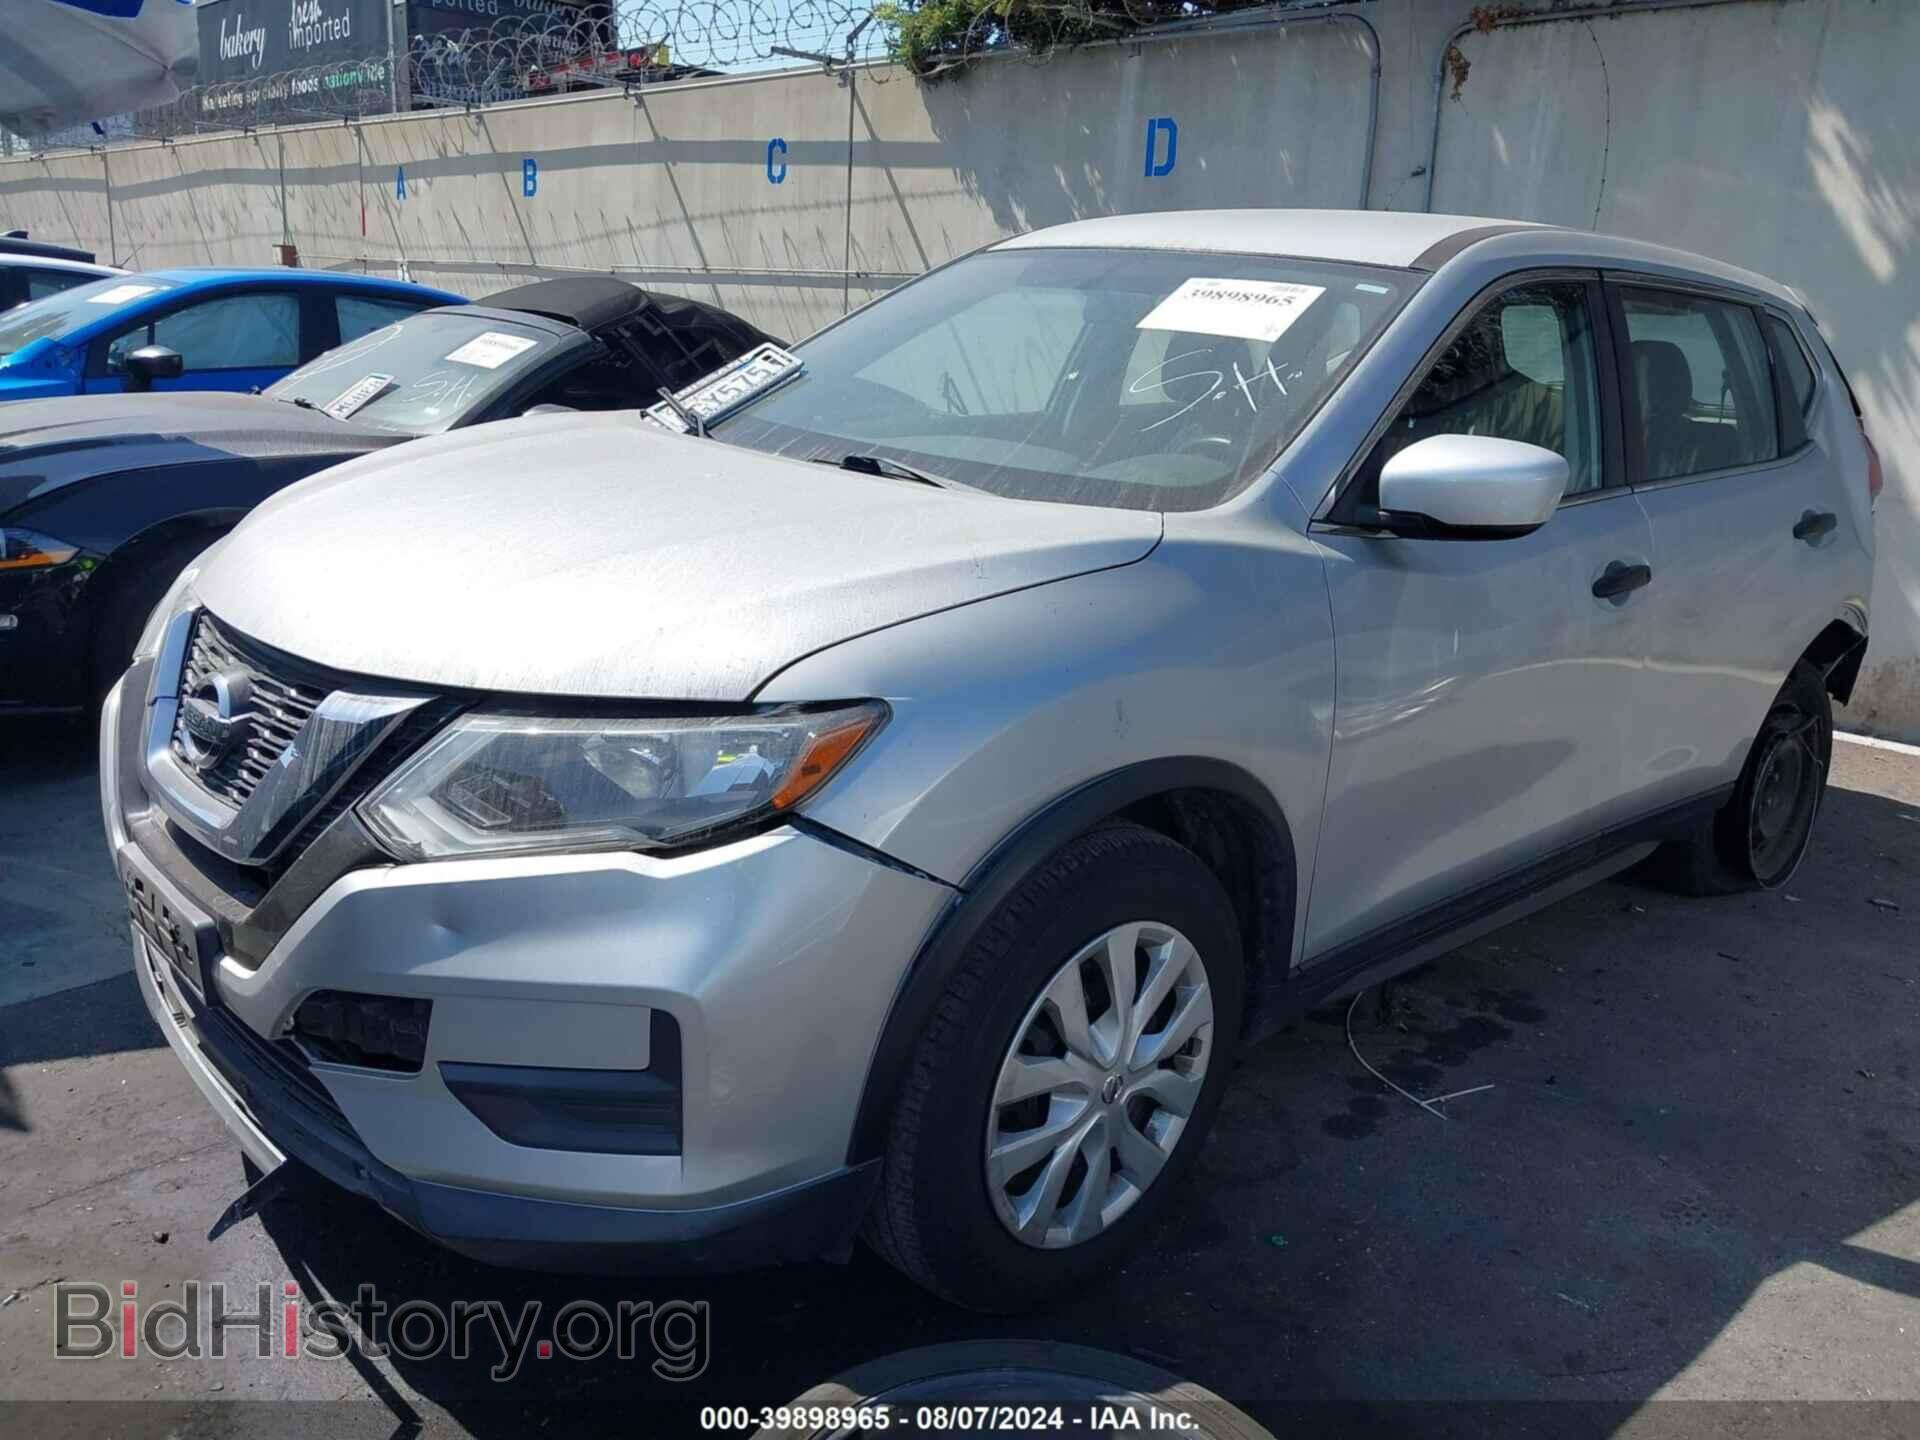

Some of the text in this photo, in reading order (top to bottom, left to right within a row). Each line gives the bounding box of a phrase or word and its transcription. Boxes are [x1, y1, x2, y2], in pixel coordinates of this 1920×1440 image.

[219, 14, 265, 70] bakery
[288, 8, 350, 52] imported
[767, 137, 788, 185] C
[1144, 117, 1179, 177] D
[396, 165, 407, 200] A
[522, 158, 538, 198] B
